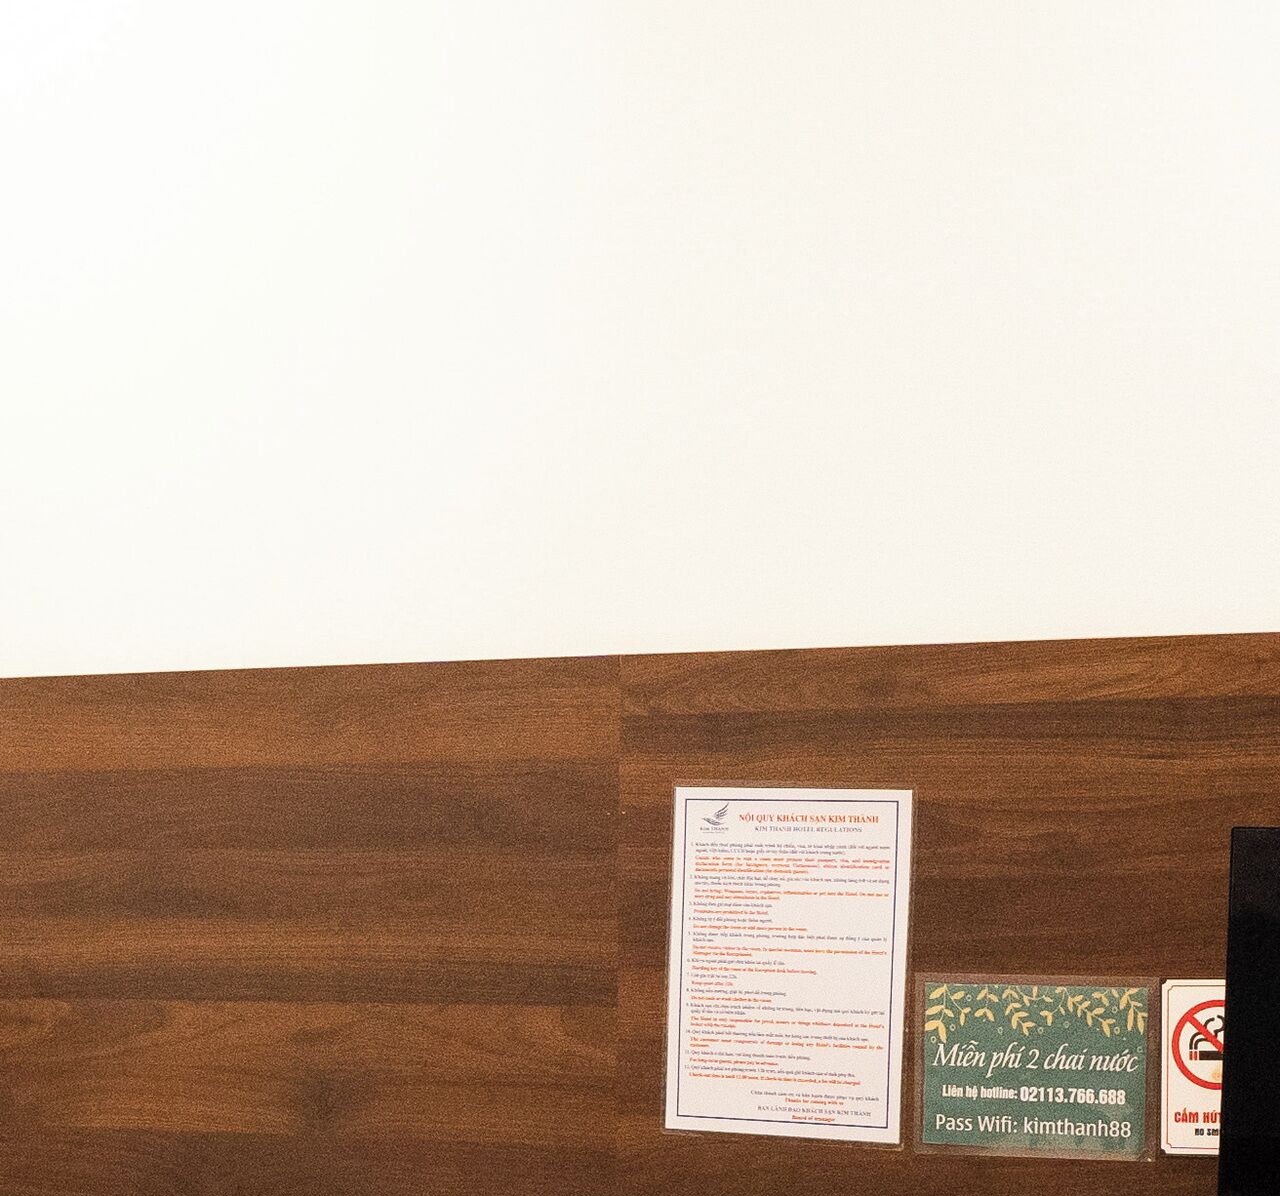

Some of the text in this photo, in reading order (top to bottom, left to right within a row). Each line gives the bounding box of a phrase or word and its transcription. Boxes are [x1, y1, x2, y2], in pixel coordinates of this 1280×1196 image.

[756, 814, 774, 823] QUY
[828, 815, 846, 824] KIM
[932, 1040, 1139, 1078] Miễn phí 2 chai nước
[942, 1084, 1126, 1105] Liên hệ hotline: 02113.766.688
[936, 1114, 1131, 1138] Pass Wifi: kimthanh88
